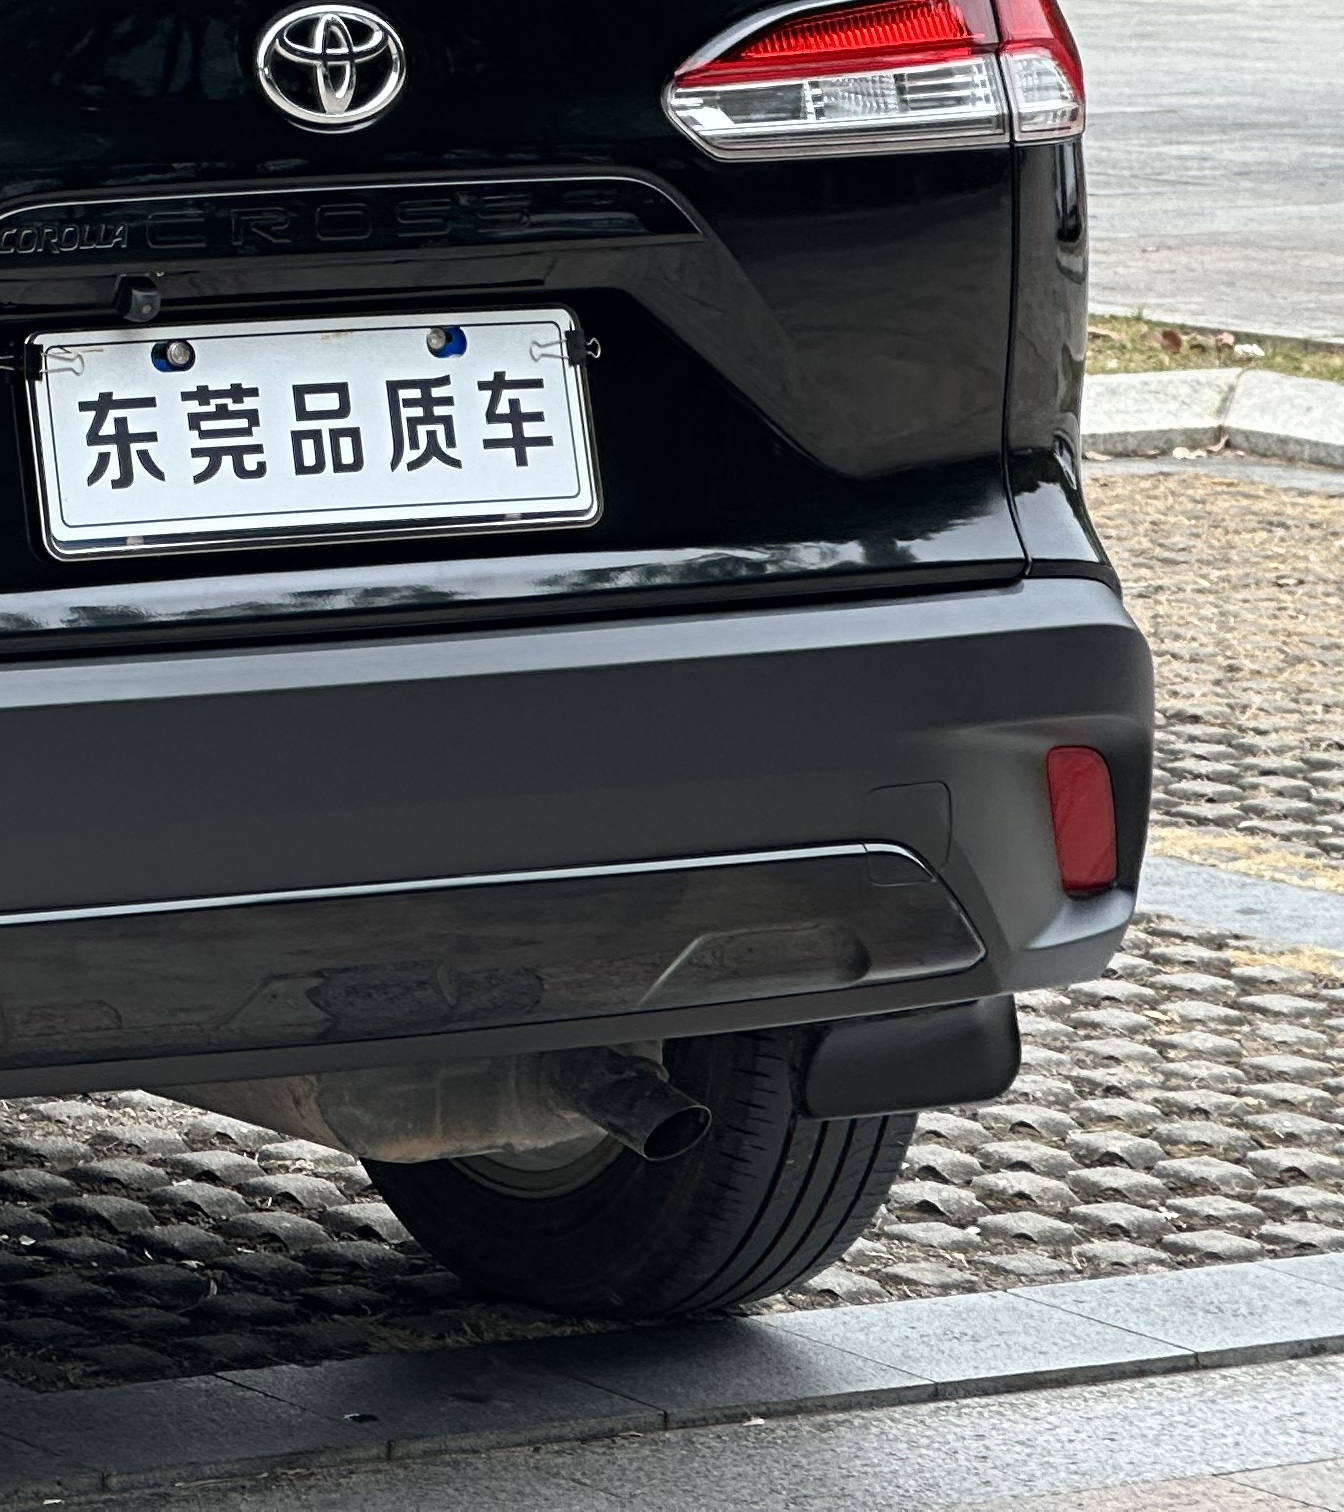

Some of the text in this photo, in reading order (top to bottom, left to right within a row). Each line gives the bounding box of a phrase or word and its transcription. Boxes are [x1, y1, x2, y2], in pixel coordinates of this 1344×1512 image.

[145, 194, 532, 249] CROSS
[78, 370, 554, 489] 东莞品质车
